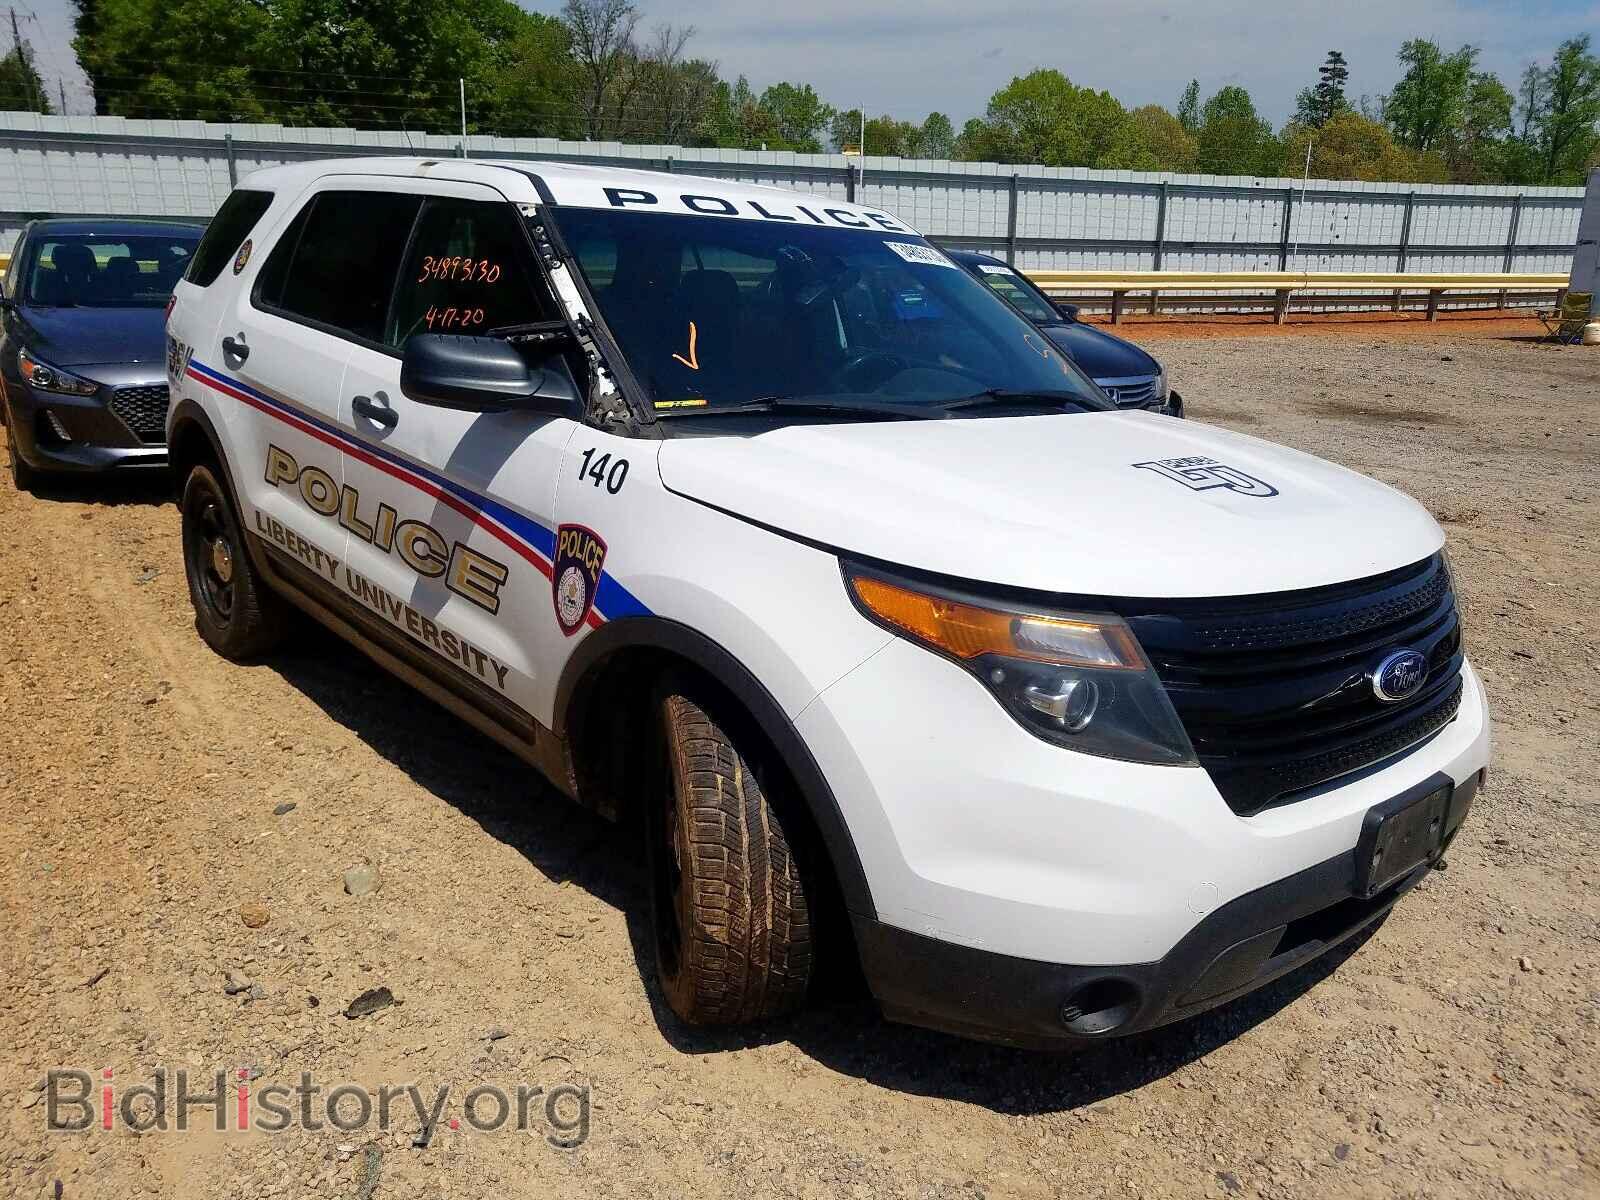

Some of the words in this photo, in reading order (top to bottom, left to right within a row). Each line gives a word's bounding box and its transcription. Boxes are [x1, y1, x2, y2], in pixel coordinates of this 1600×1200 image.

[602, 187, 905, 232] POLICE
[418, 256, 501, 283] 34893130
[578, 447, 630, 495] 140
[264, 443, 509, 616] POLICE
[558, 530, 604, 584] POLICE
[255, 510, 341, 579] LIBERTY
[346, 568, 509, 690] UNIVERSITY
[1386, 660, 1423, 689] Ford
